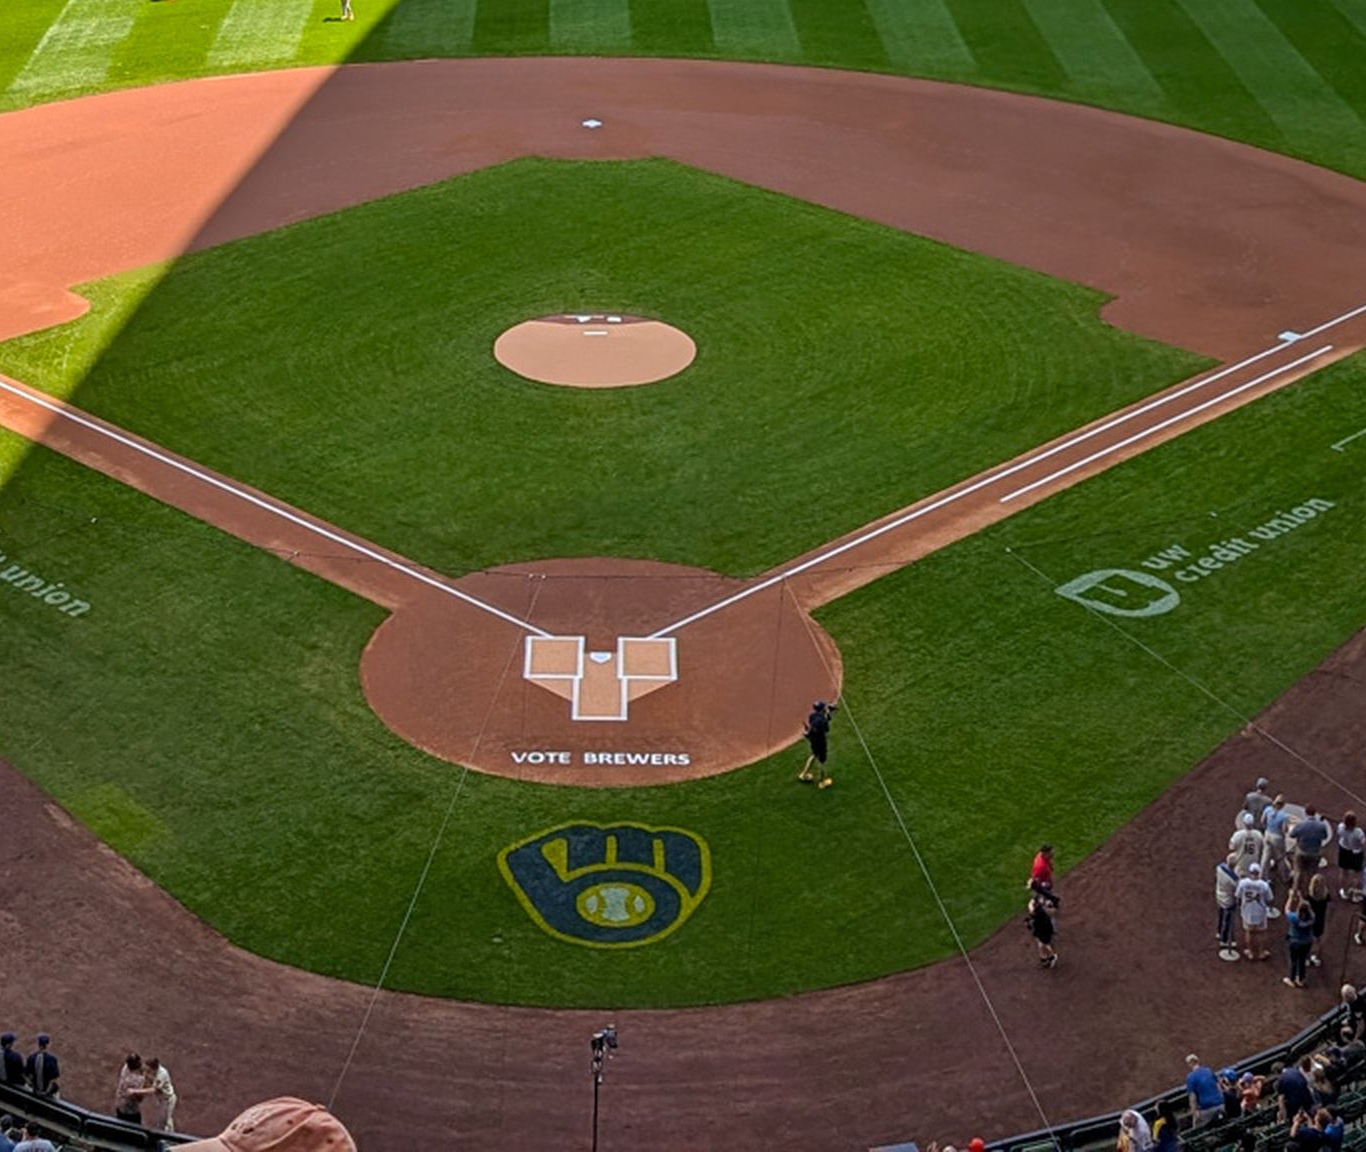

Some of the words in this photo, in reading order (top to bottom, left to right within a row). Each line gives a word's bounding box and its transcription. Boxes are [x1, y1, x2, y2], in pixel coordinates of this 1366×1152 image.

[1173, 537, 1260, 582] credit
[1248, 497, 1337, 541] union
[1141, 544, 1192, 570] uw
[511, 751, 572, 765] VOTE
[583, 751, 691, 766] BREWERS
[1244, 891, 1261, 903] 54
